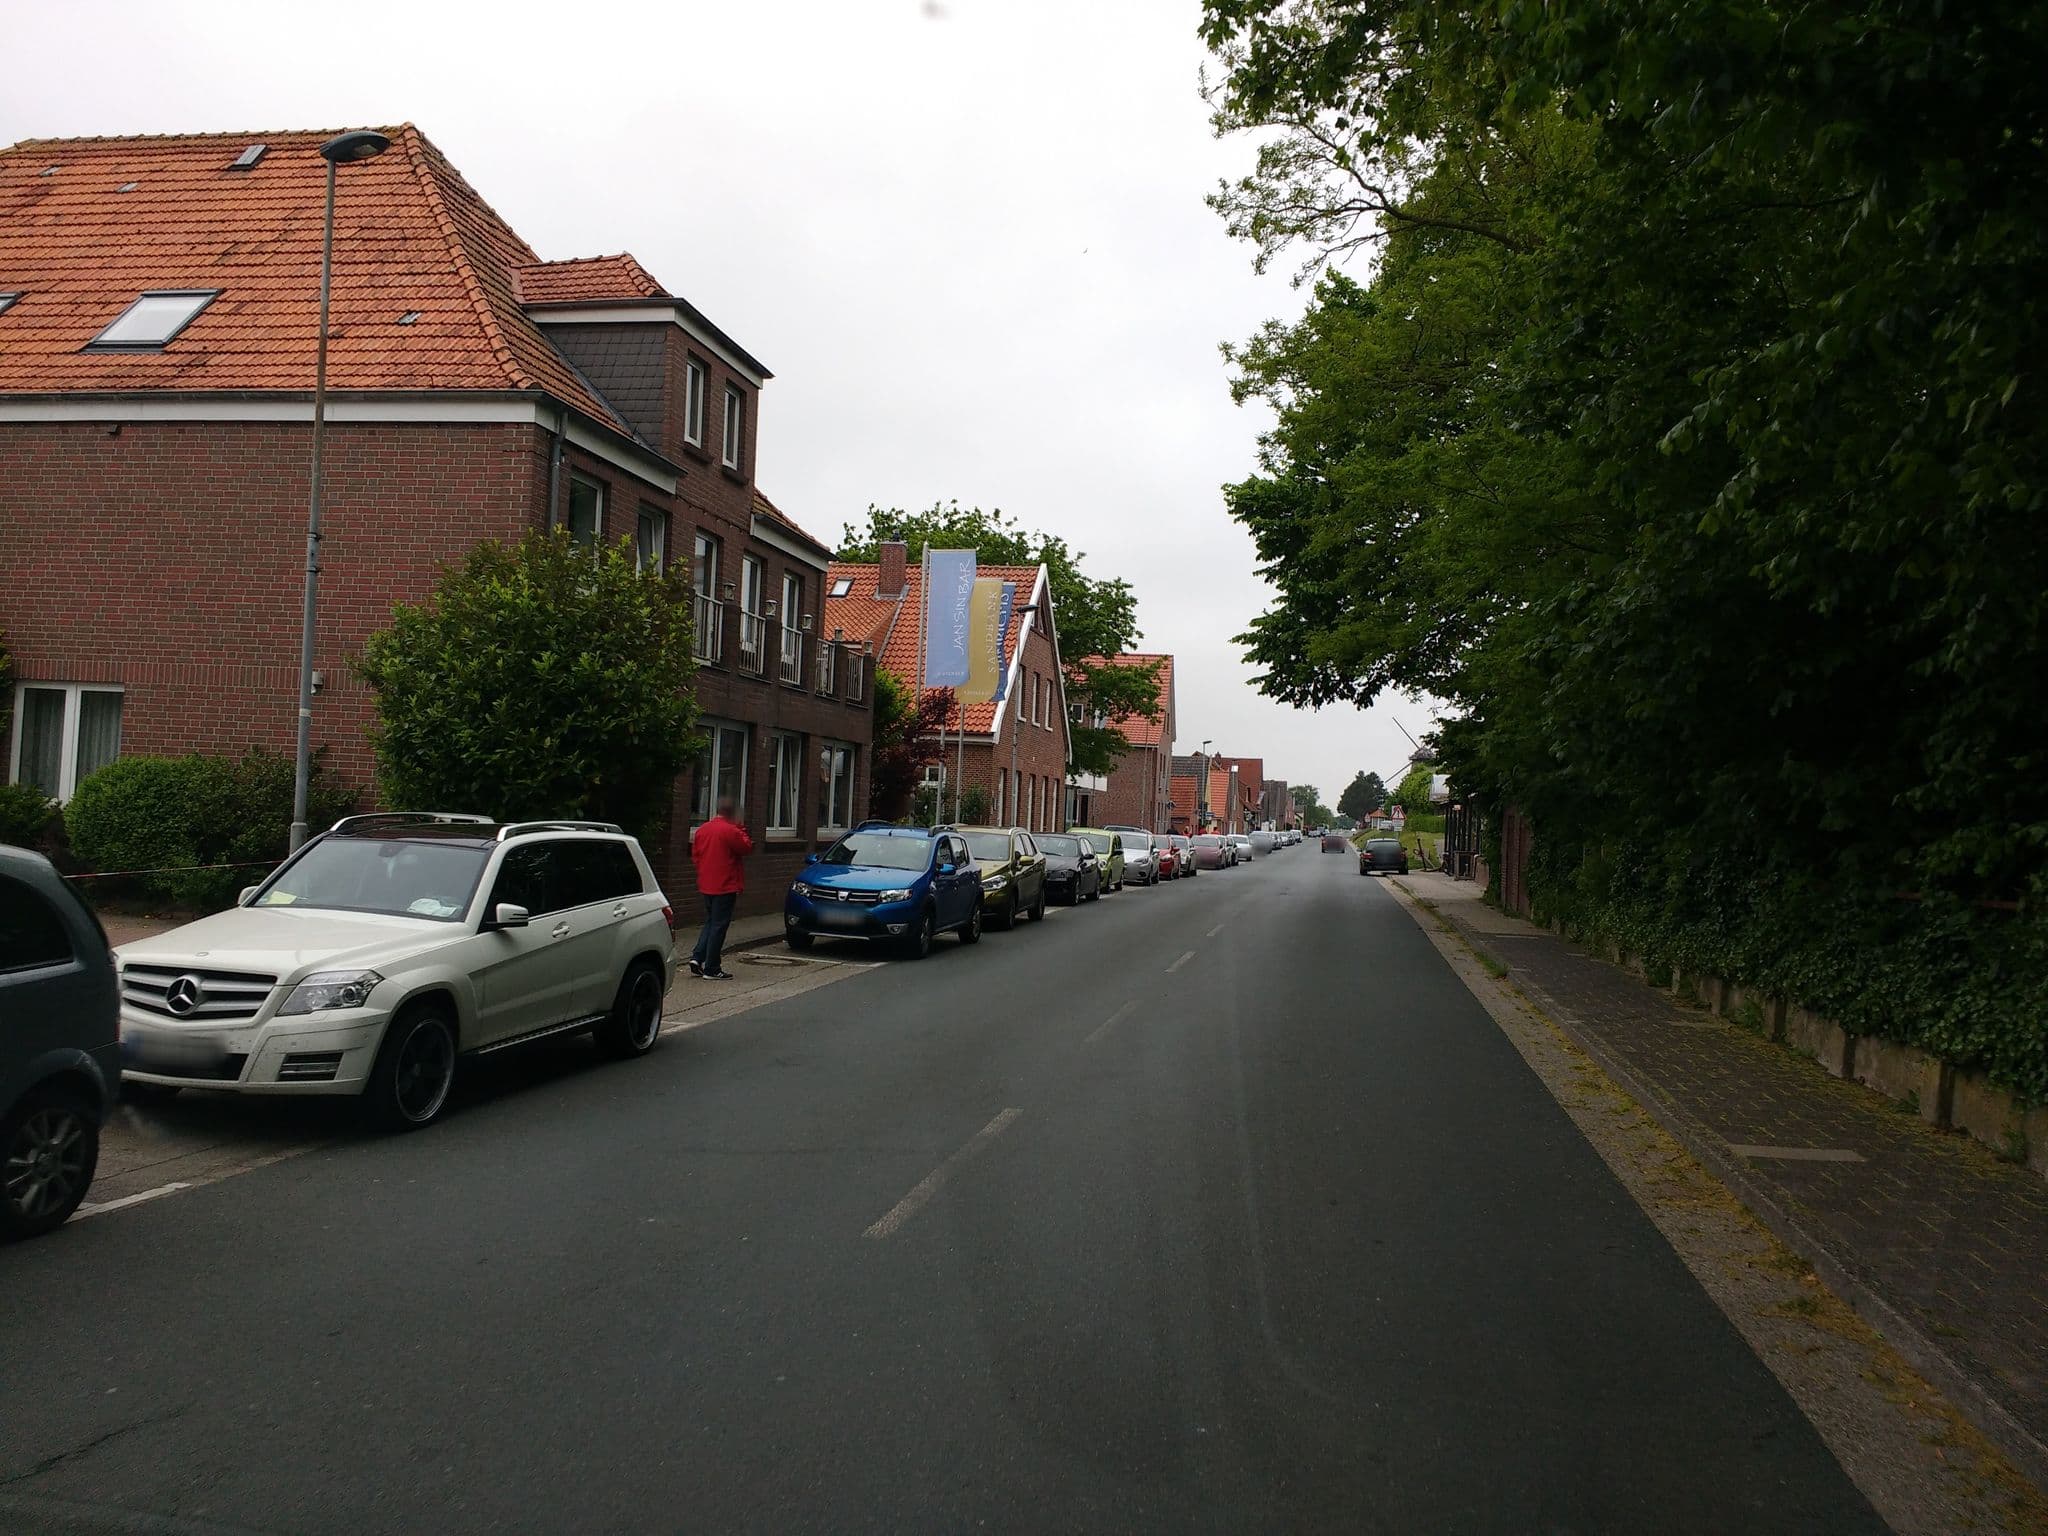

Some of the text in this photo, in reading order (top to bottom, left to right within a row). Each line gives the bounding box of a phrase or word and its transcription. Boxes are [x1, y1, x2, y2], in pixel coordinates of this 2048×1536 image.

[952, 559, 971, 656] JAN SIN BAR
[986, 591, 998, 673] SANDBANK
